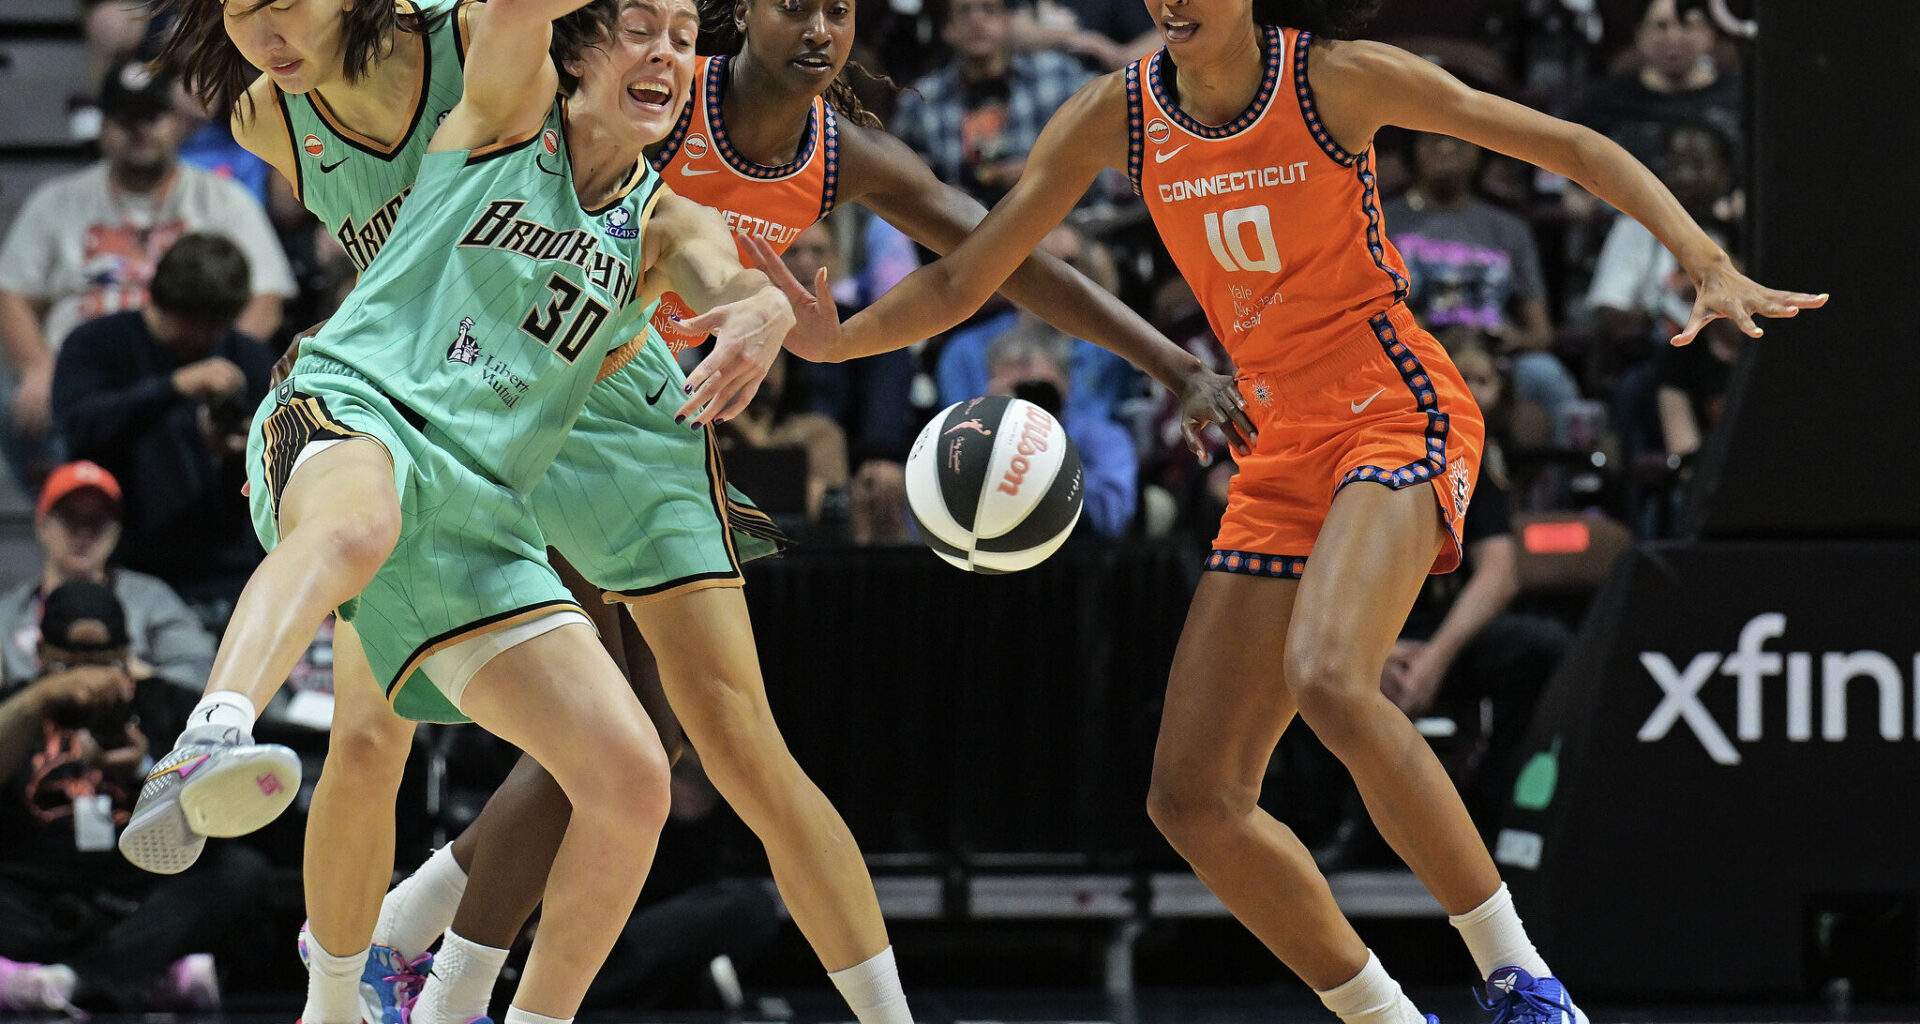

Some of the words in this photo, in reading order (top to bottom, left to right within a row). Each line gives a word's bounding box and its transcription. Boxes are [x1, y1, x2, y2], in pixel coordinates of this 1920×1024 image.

[1158, 161, 1309, 203] CONNECTICUT
[721, 209, 802, 244] ECTICUT
[1203, 204, 1282, 274] 10
[455, 199, 632, 313] BROOKYN
[518, 271, 612, 367] 30
[1227, 283, 1253, 300] Yale
[484, 354, 530, 394] Libert
[996, 405, 1053, 497] Wilson
